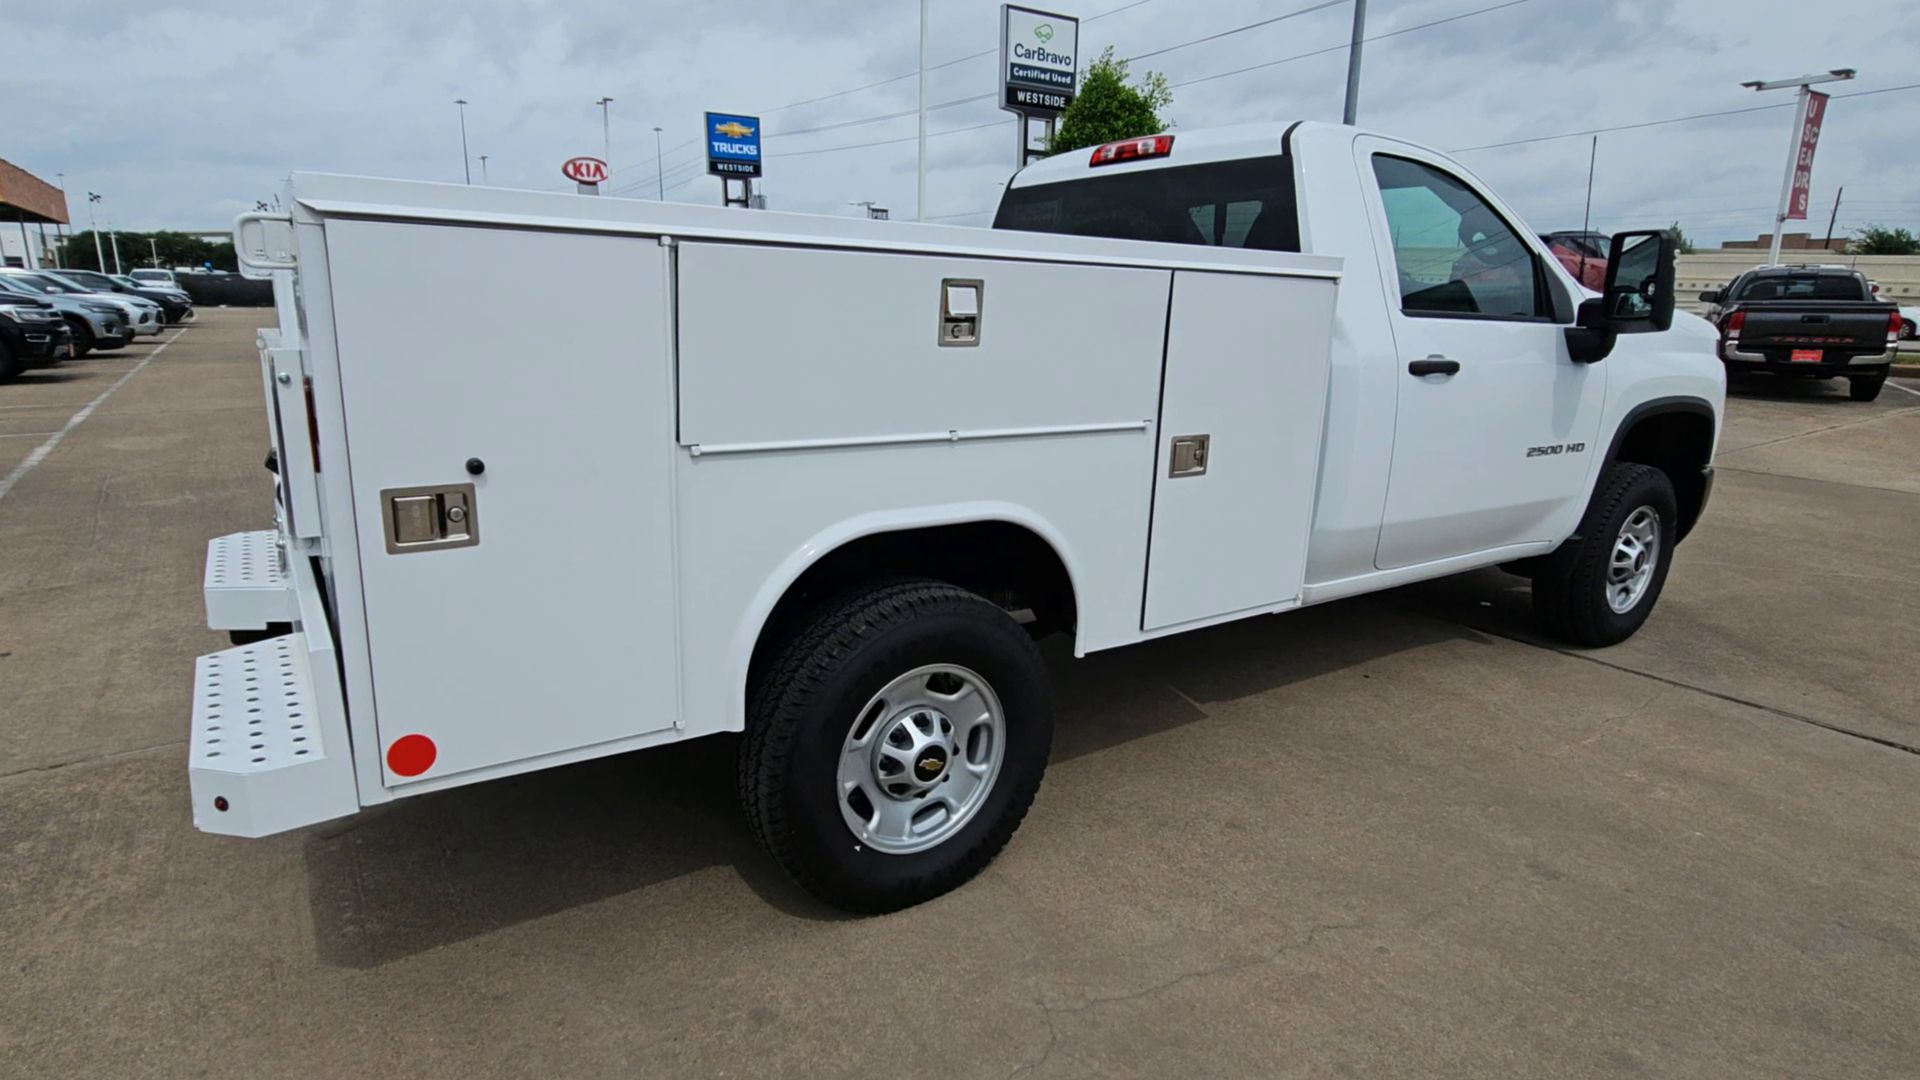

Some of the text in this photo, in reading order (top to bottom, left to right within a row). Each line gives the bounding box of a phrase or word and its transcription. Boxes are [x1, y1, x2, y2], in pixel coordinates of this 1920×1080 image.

[1014, 43, 1072, 66] CarBravo
[1013, 67, 1071, 84] Certified Used
[1017, 91, 1066, 107] WESTSIDE
[712, 141, 758, 155] TRUCKS
[572, 161, 604, 179] KIA
[717, 163, 754, 173] WESTSIDE
[1526, 442, 1585, 458] 2500 HD
